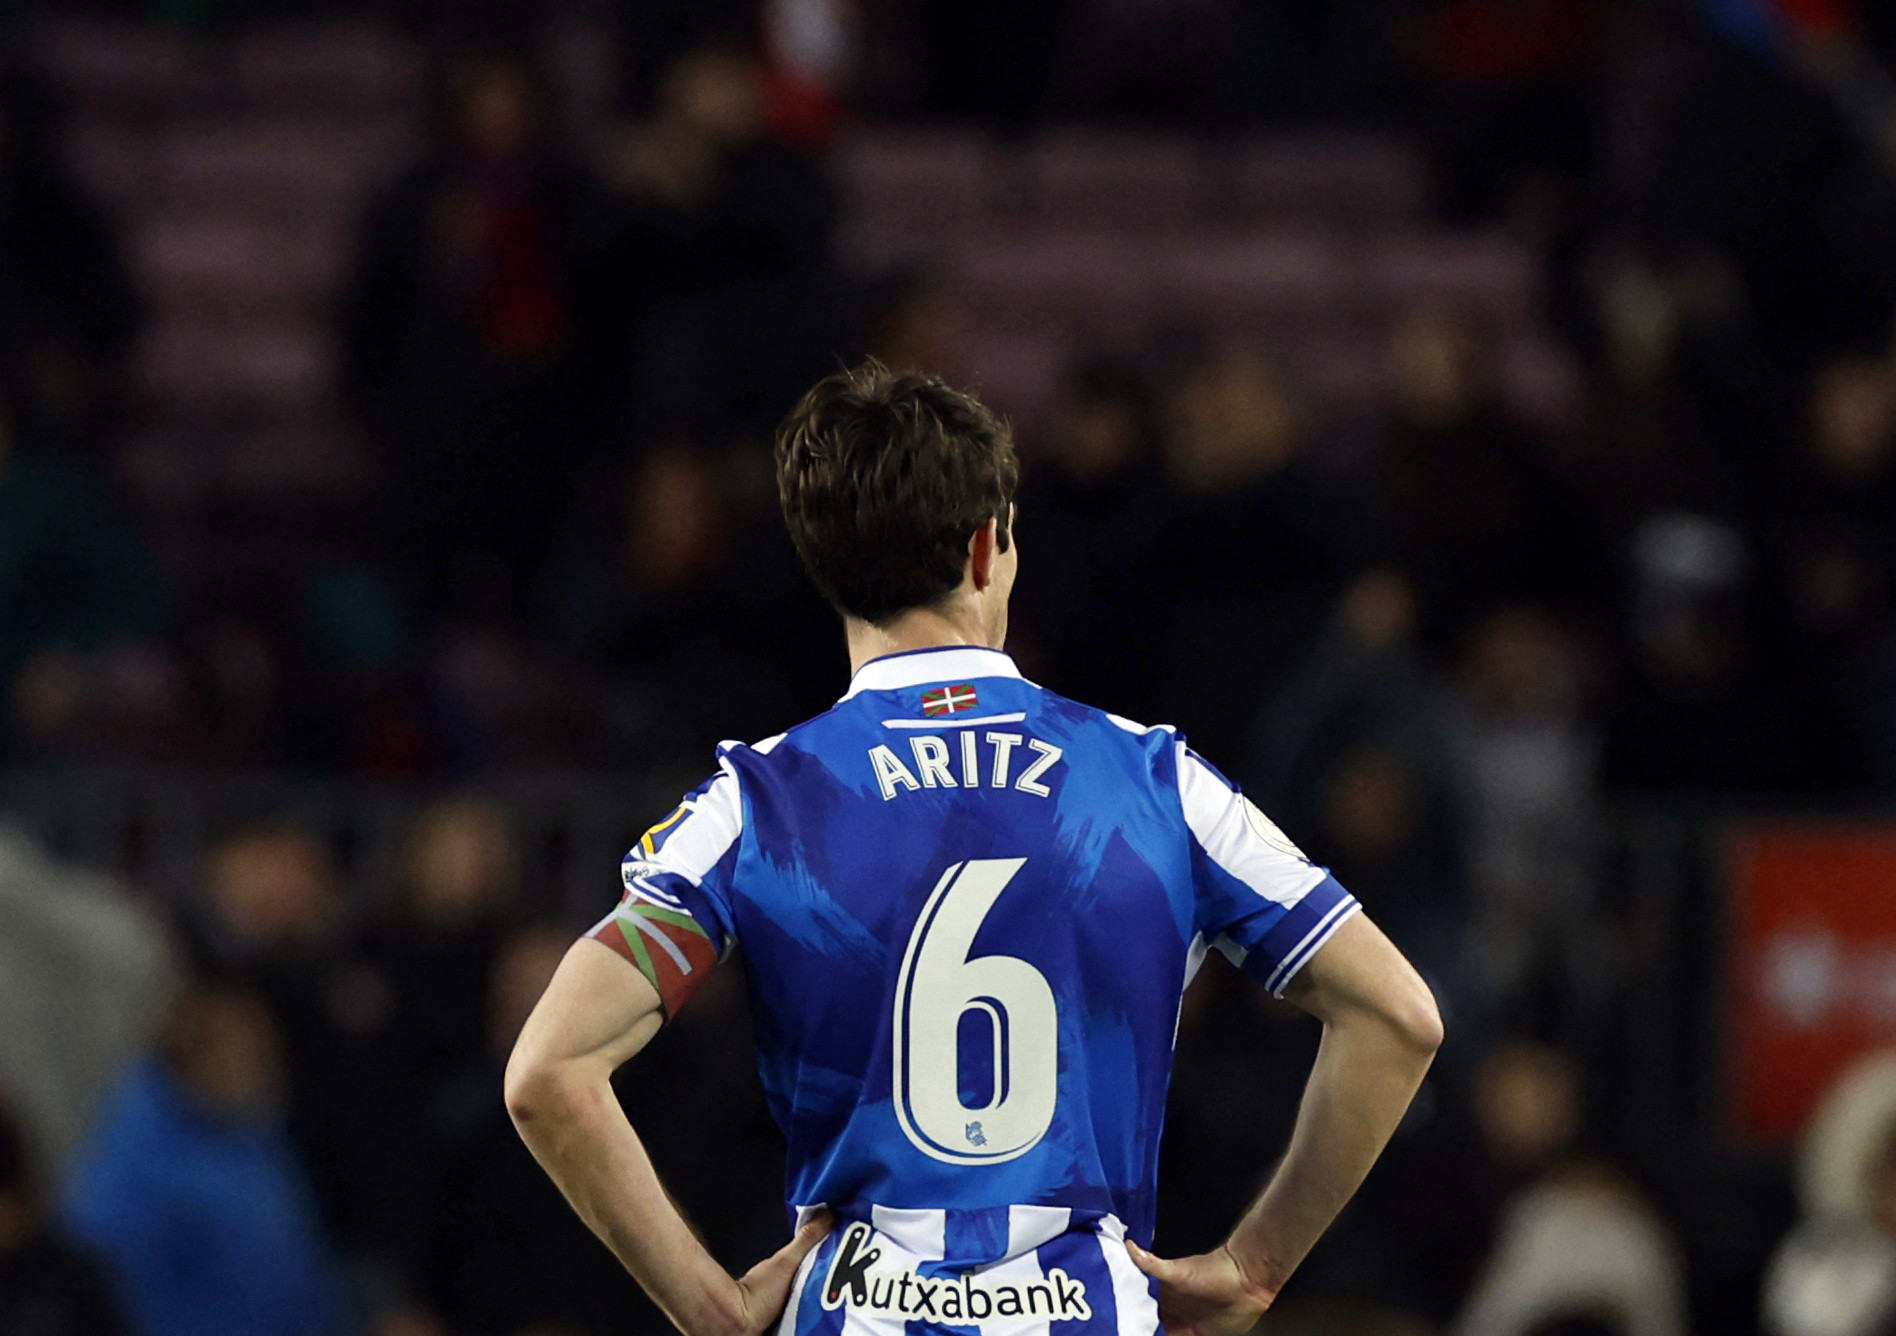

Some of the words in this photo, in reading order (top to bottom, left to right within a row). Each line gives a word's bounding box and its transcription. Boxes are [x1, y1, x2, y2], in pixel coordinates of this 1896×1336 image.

[867, 731, 1064, 801] ARITZ
[893, 857, 1058, 1166] 6
[827, 1227, 1086, 1319] Kutxabank
